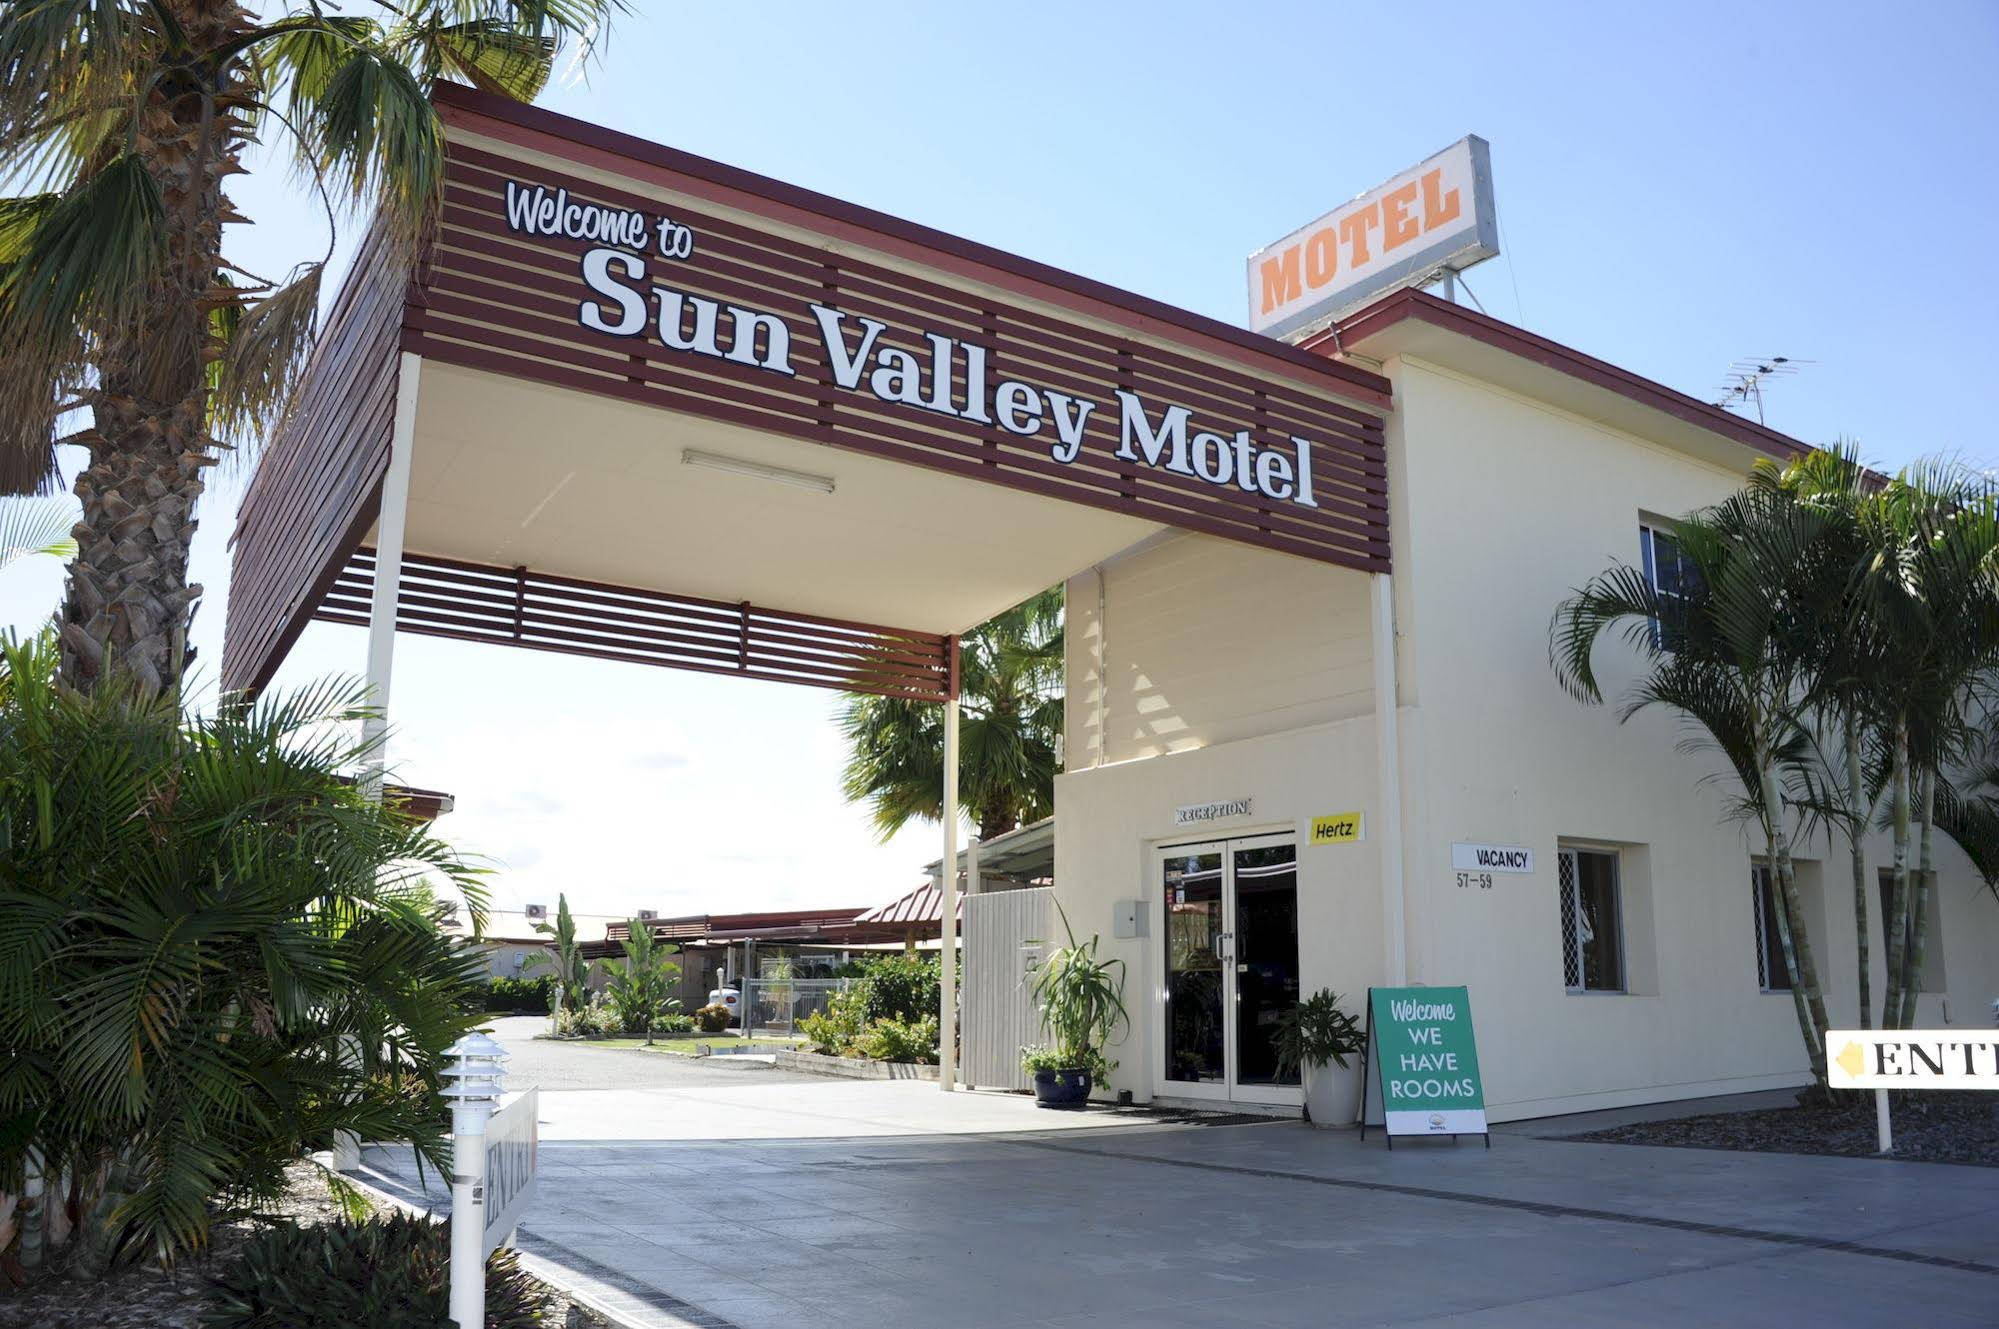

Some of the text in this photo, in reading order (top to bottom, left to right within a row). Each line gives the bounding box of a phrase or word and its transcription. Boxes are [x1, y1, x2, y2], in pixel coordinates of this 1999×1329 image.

[505, 180, 694, 260] Welcome to
[1260, 167, 1460, 316] MOTEL
[579, 247, 1319, 509] Sun Valley Motel
[1176, 800, 1249, 823] RECEPTION
[1315, 819, 1354, 840] Hertz
[1476, 848, 1528, 868] VACANCY
[1390, 999, 1456, 1022] Welcome
[1408, 1027, 1443, 1045] WE
[1400, 1053, 1458, 1072] HAVE
[1390, 1078, 1475, 1098] ROOMS
